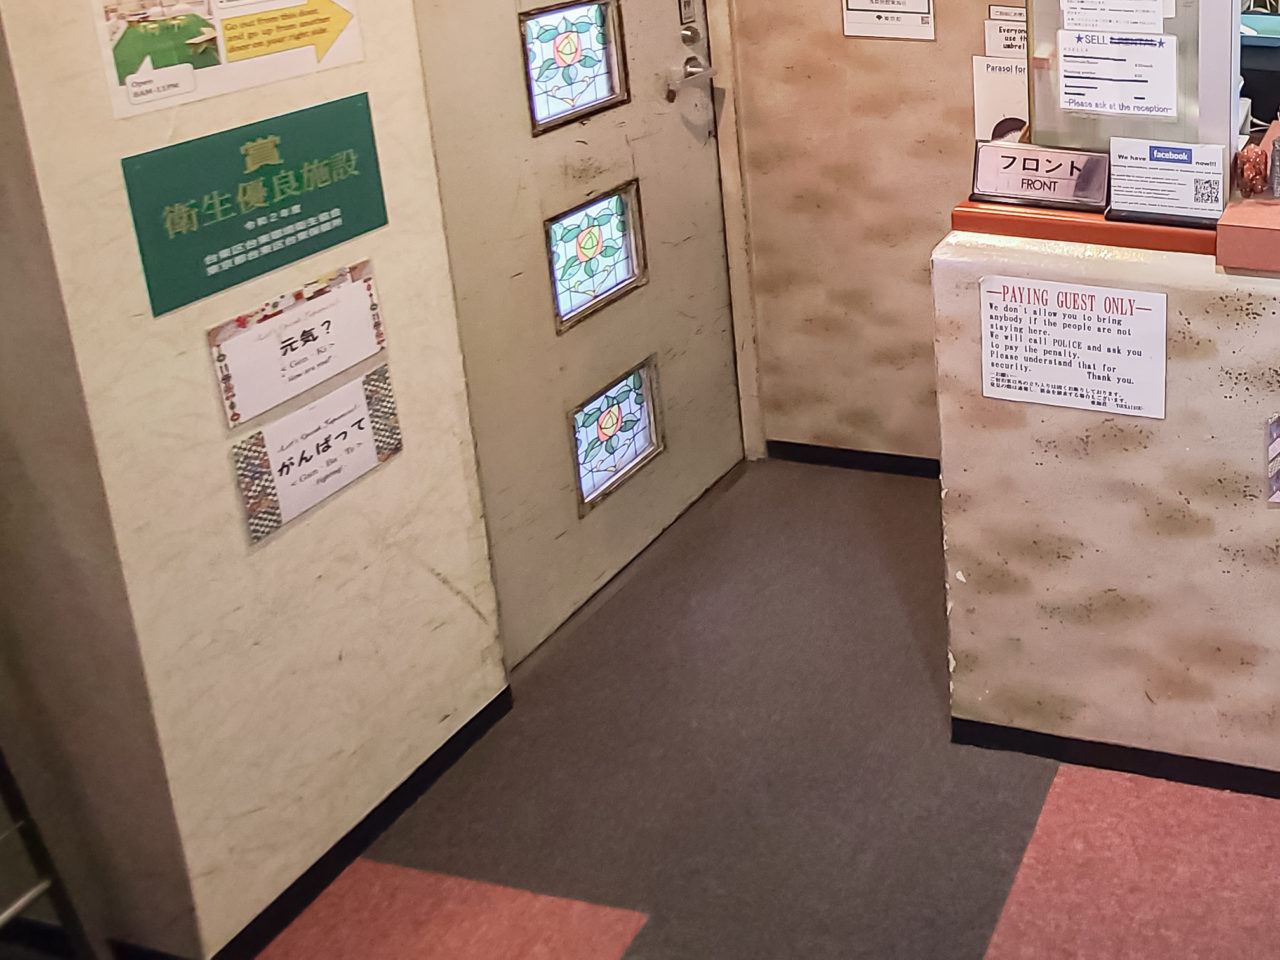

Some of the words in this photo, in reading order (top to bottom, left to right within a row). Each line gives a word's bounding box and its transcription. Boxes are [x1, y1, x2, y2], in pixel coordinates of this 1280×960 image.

[1084, 34, 1109, 45] SELL
[986, 64, 1013, 72] Parasol
[1015, 65, 1026, 74] for
[1095, 101, 1107, 110] ask
[1118, 101, 1131, 111] the
[1153, 149, 1188, 161] facebook
[1000, 155, 1083, 173] フロント
[1021, 178, 1058, 192] FRONT
[162, 148, 359, 239] 衛生優良施設
[1057, 291, 1096, 312] GUEST
[989, 302, 998, 311] We
[1033, 307, 1057, 317] allow
[1097, 314, 1122, 326] bring
[990, 314, 1022, 324] anybody
[1029, 317, 1037, 325] if
[1044, 319, 1057, 327] the
[1063, 322, 1092, 331] people
[1117, 328, 1131, 336] not
[990, 323, 1023, 333] staying
[990, 331, 999, 339] We
[1004, 333, 1022, 342] will
[1029, 337, 1046, 345] call
[1053, 338, 1082, 349] POLICE
[1087, 344, 1101, 352] and
[1107, 346, 1121, 354] ask
[1127, 349, 1142, 357] you
[991, 341, 999, 349] to
[1005, 344, 1018, 352] pay
[1025, 345, 1037, 353] the
[991, 350, 1018, 359] Please
[1024, 356, 1072, 367] understand
[1079, 361, 1096, 370] that
[1103, 364, 1116, 372] for
[1087, 372, 1111, 382] Thank
[277, 417, 365, 477] がんばって
